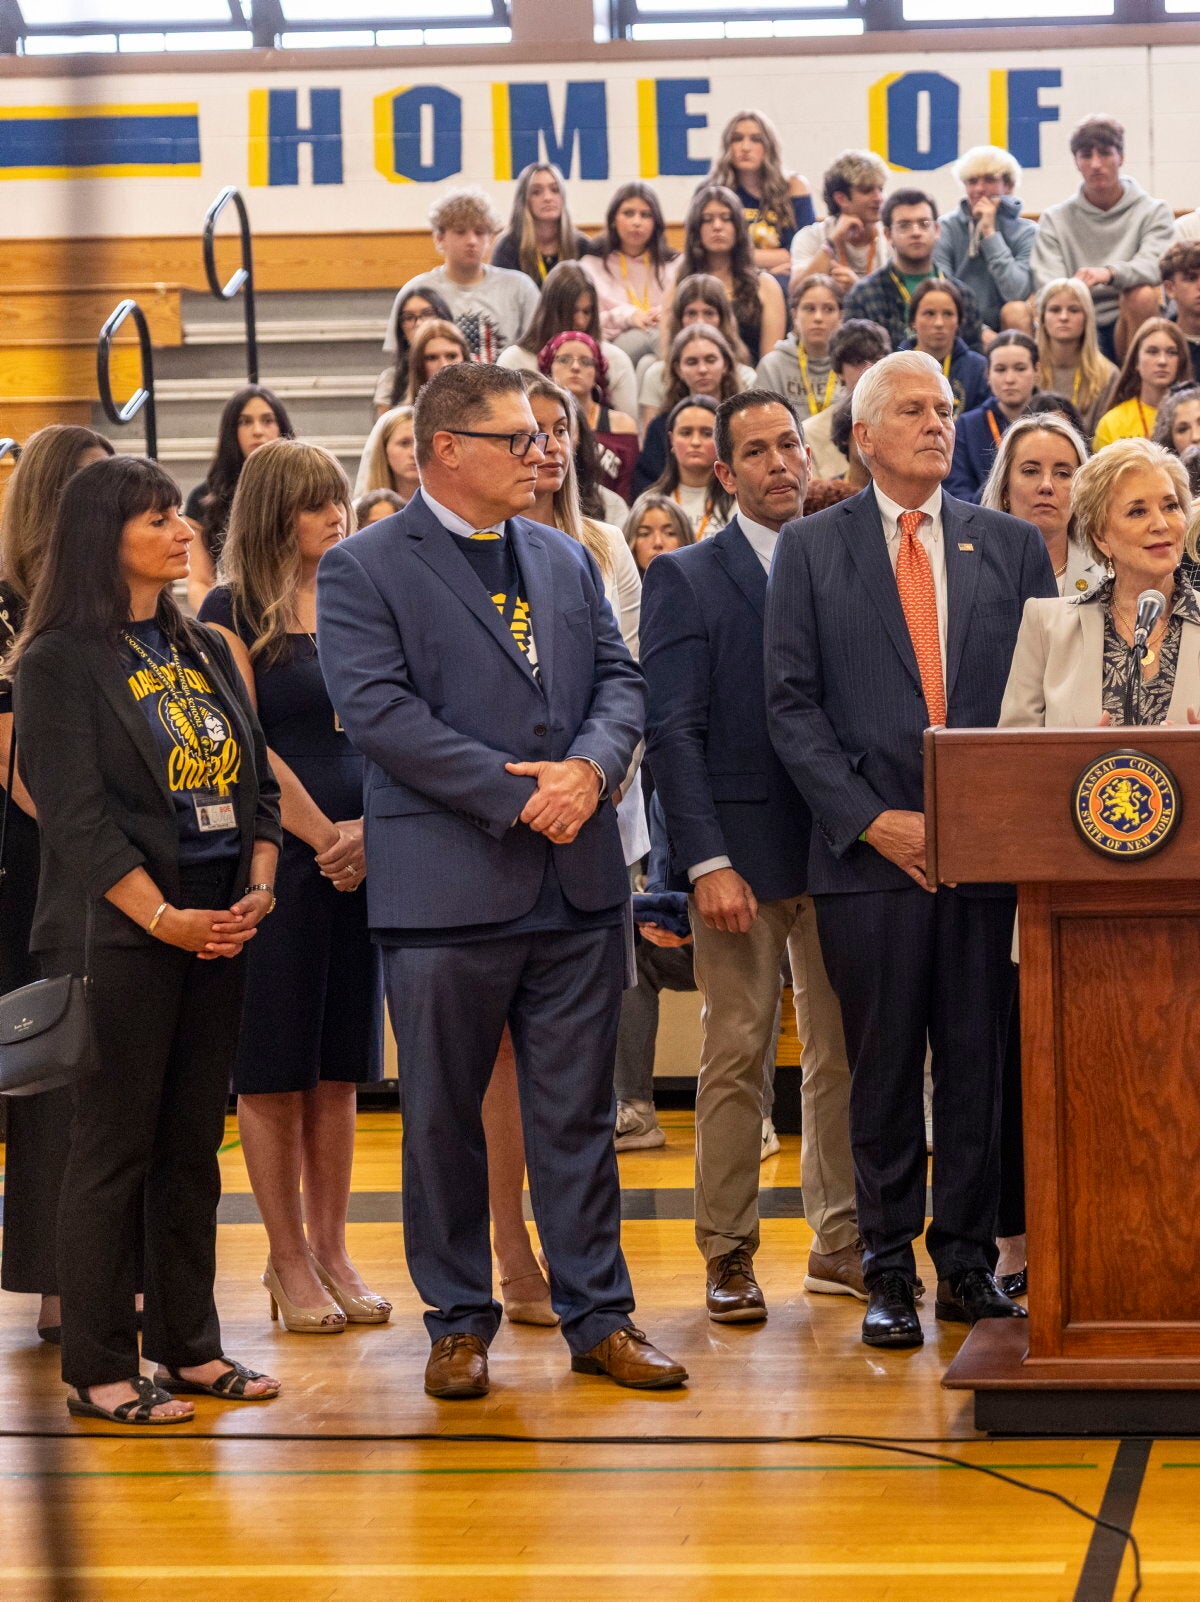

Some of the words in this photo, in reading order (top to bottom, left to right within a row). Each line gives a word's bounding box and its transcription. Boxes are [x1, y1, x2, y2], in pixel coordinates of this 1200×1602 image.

[248, 78, 713, 182] HOME
[868, 69, 1062, 172] OF
[186, 697, 204, 728] SCHOOLS
[1081, 760, 1116, 797] NASSAU
[1129, 759, 1170, 794] COUNTY
[1081, 810, 1104, 842] STATE
[1106, 840, 1122, 850] OF
[1127, 835, 1151, 850] NEW
[1153, 808, 1172, 837] YORK
